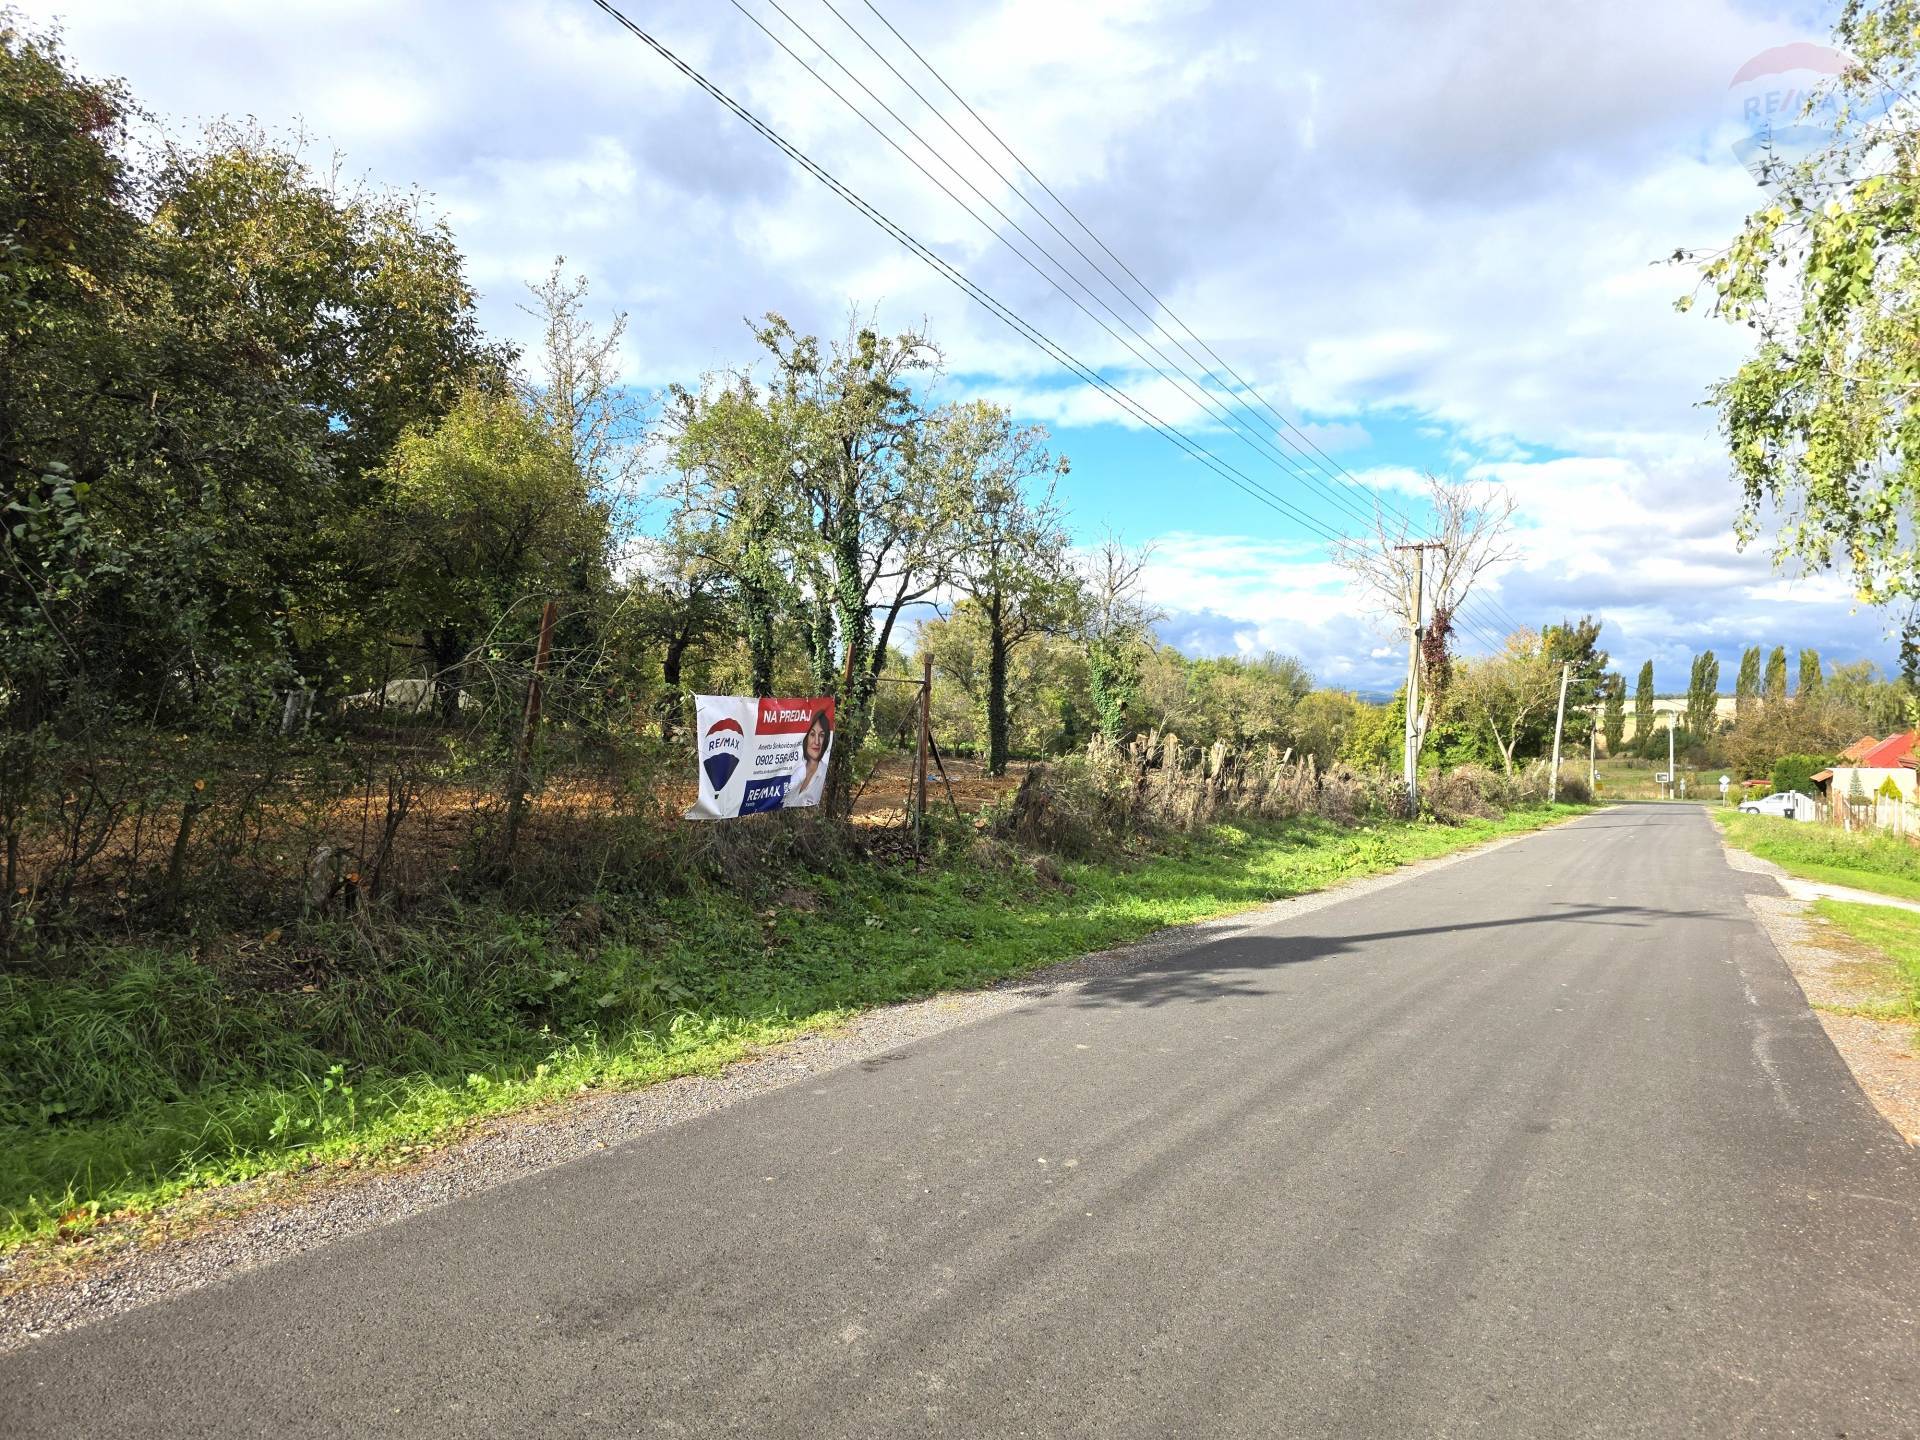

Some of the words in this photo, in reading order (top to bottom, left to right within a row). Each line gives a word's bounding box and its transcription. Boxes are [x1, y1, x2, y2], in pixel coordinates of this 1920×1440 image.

[763, 710, 777, 723] NA
[779, 709, 812, 723] PREDAJ
[708, 737, 740, 752] RE/MAX
[755, 754, 773, 766] 0902
